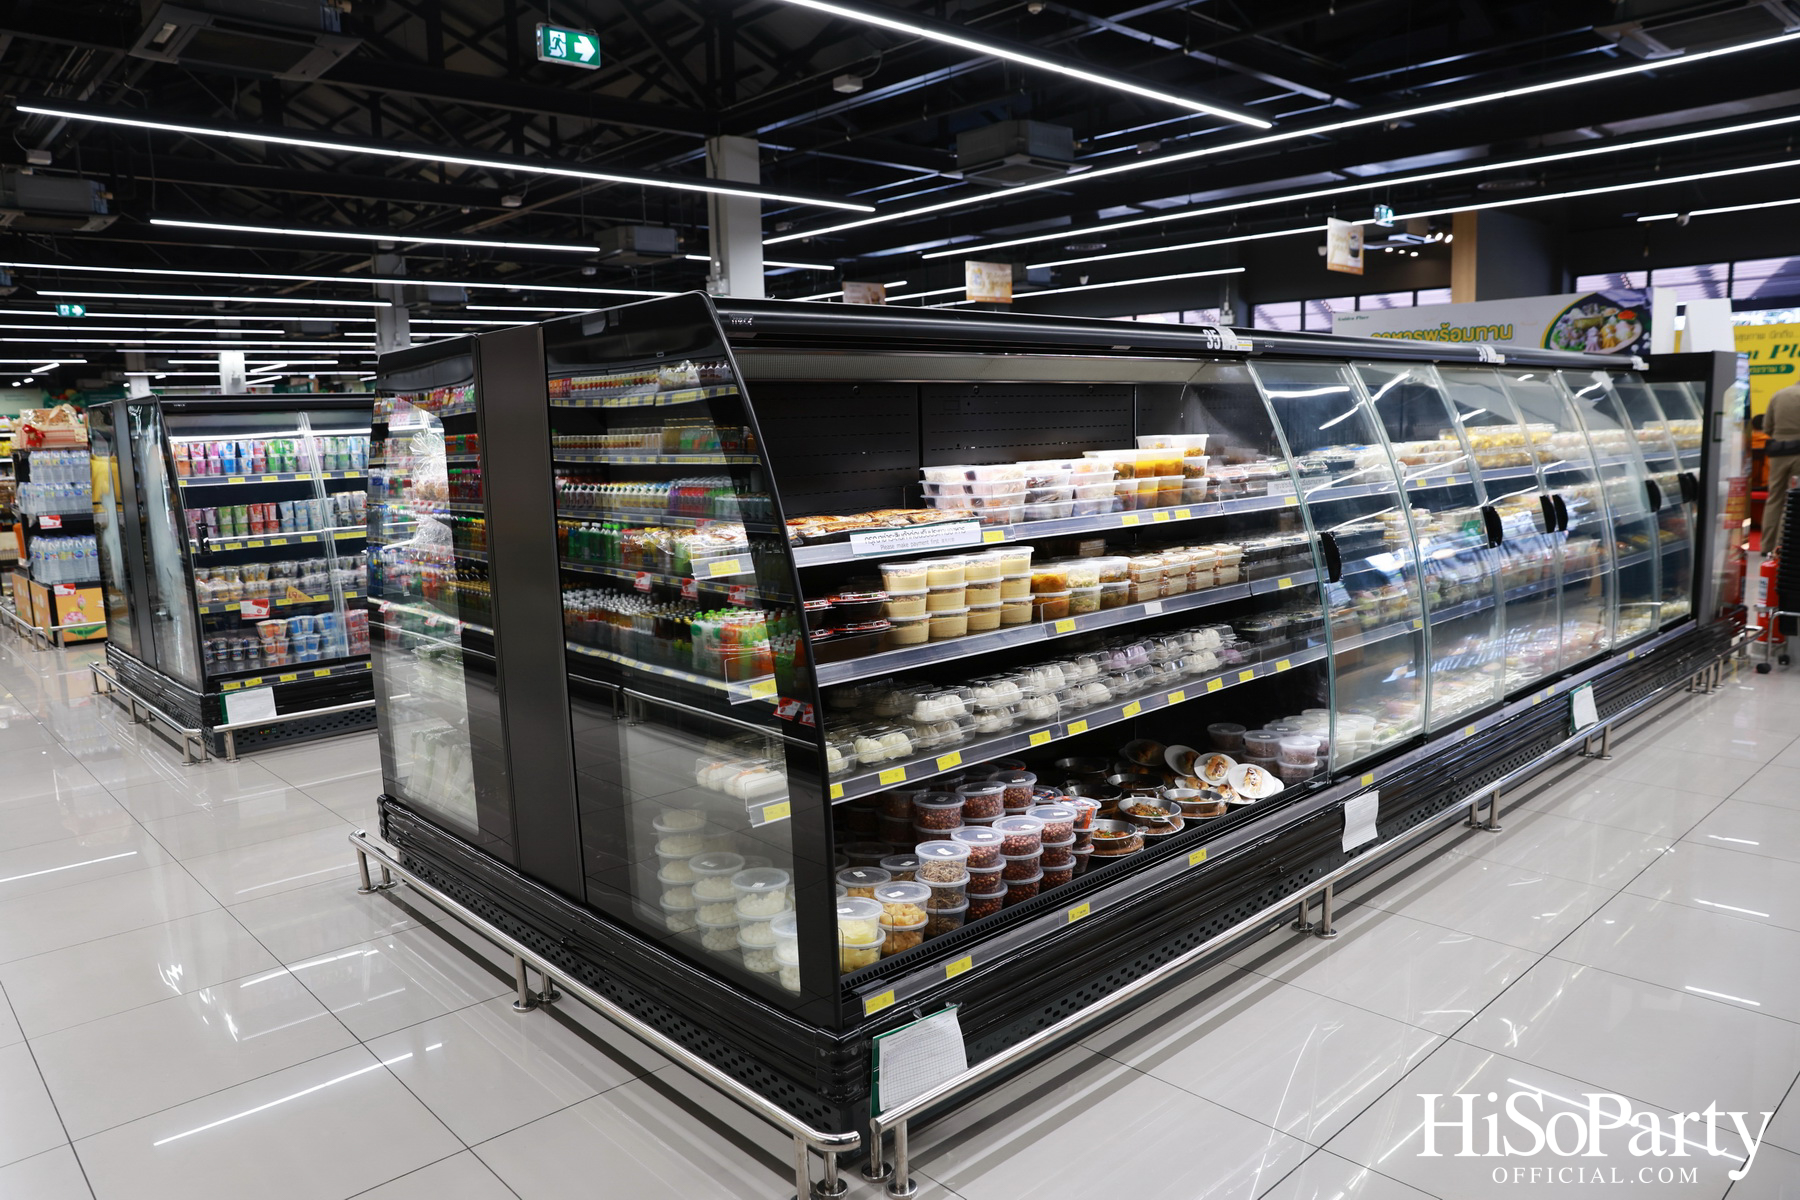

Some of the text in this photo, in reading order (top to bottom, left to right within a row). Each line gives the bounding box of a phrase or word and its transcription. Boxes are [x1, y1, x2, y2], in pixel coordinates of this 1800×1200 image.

[1203, 329, 1221, 349] 35
[880, 543, 895, 551] Please
[910, 539, 929, 547] payment
